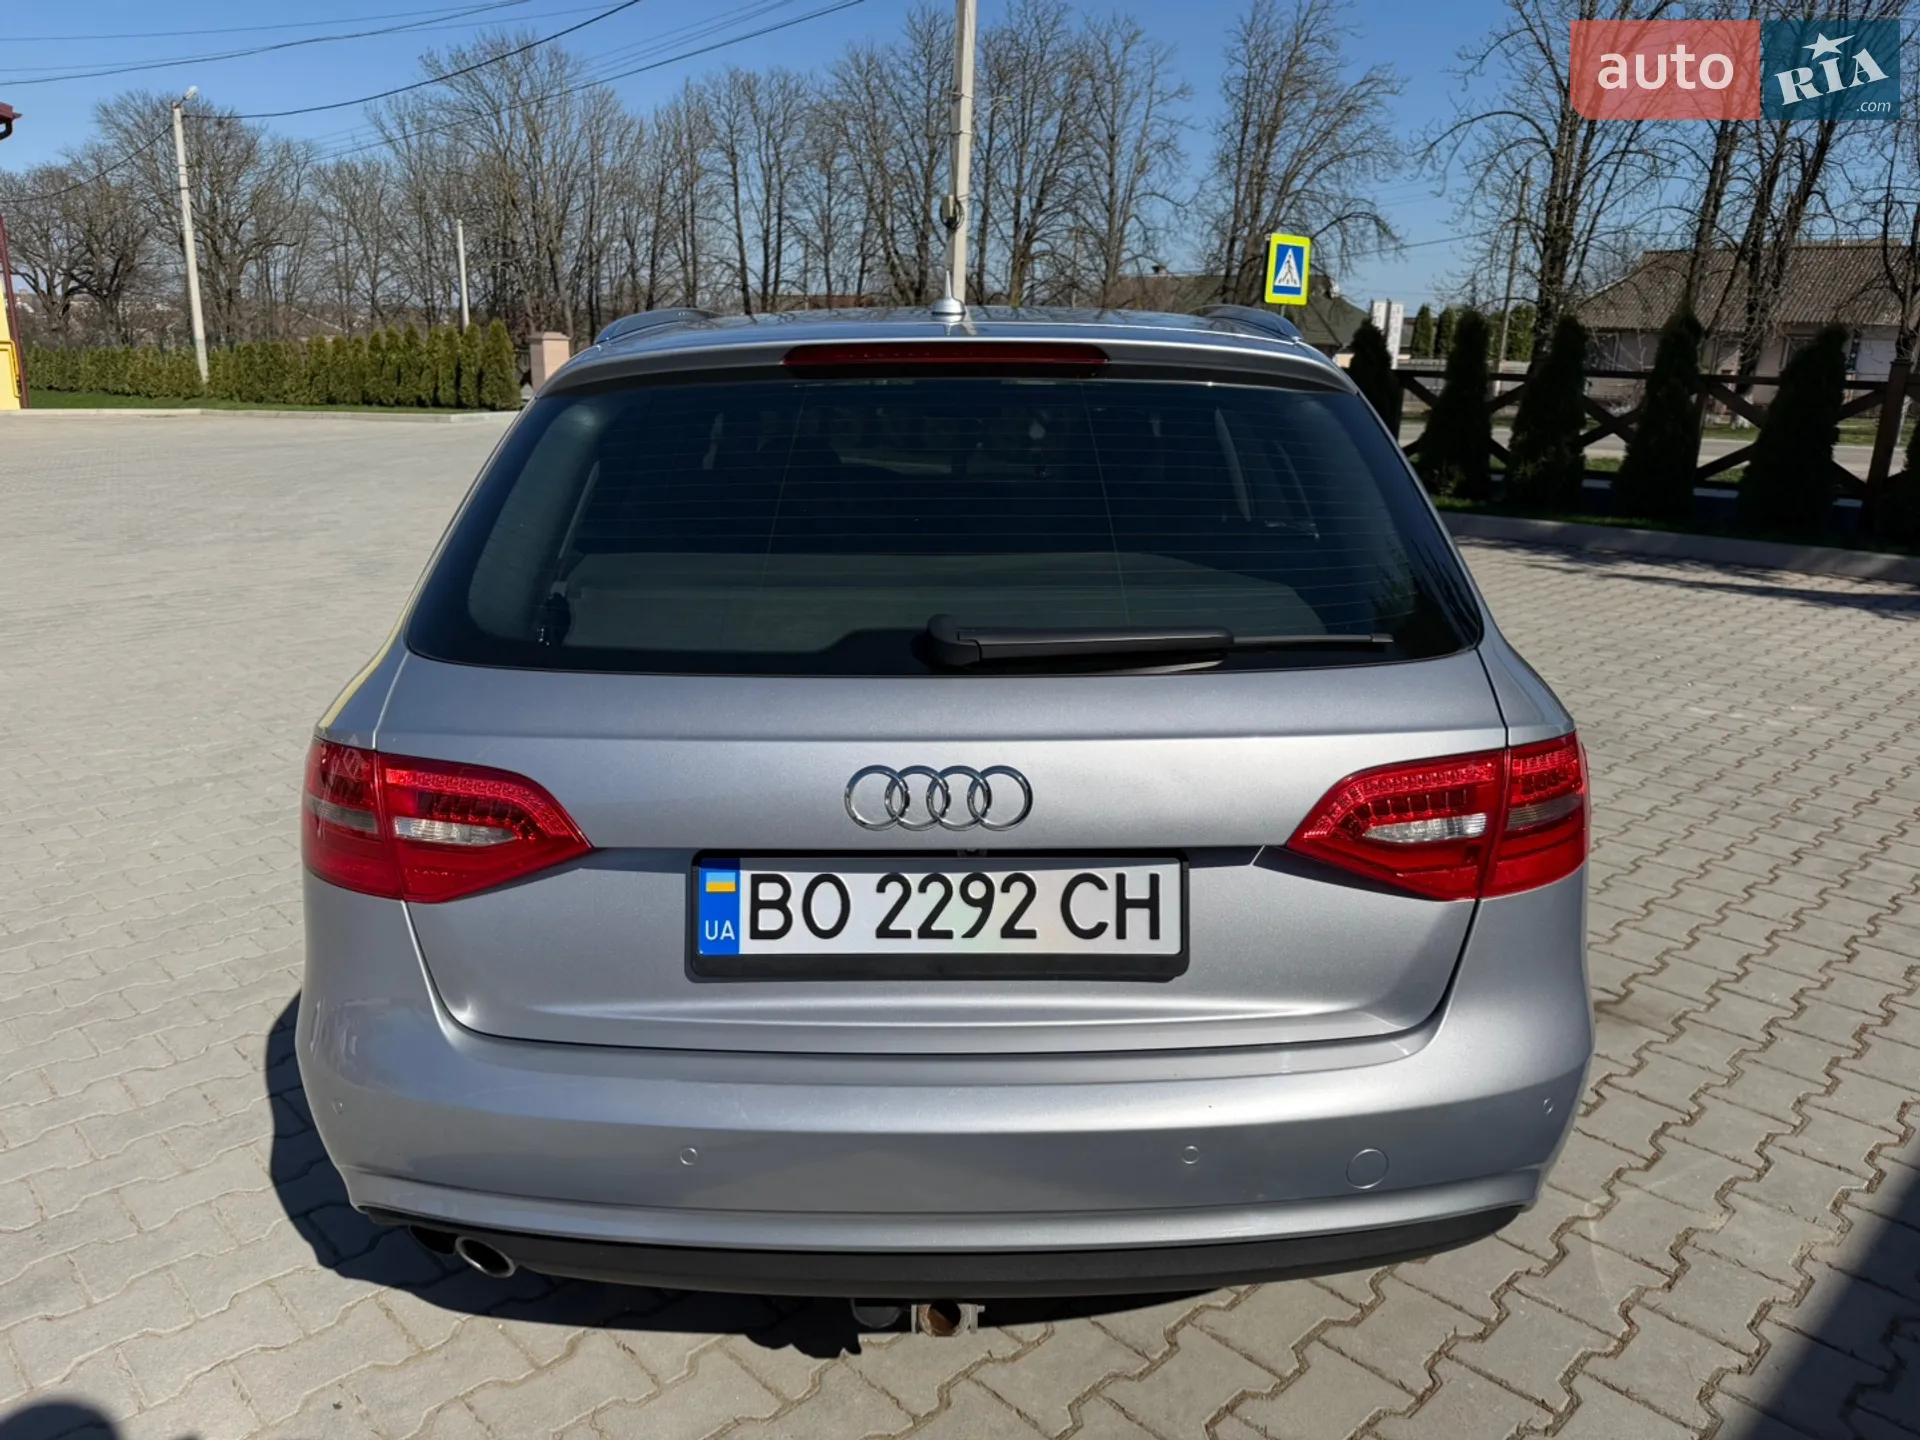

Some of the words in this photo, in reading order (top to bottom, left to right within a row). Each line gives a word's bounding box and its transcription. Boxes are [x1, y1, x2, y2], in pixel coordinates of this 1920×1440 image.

[749, 873, 851, 940] BO
[875, 872, 1038, 940] 2292
[1060, 873, 1161, 940] CH
[704, 920, 736, 941] UA
